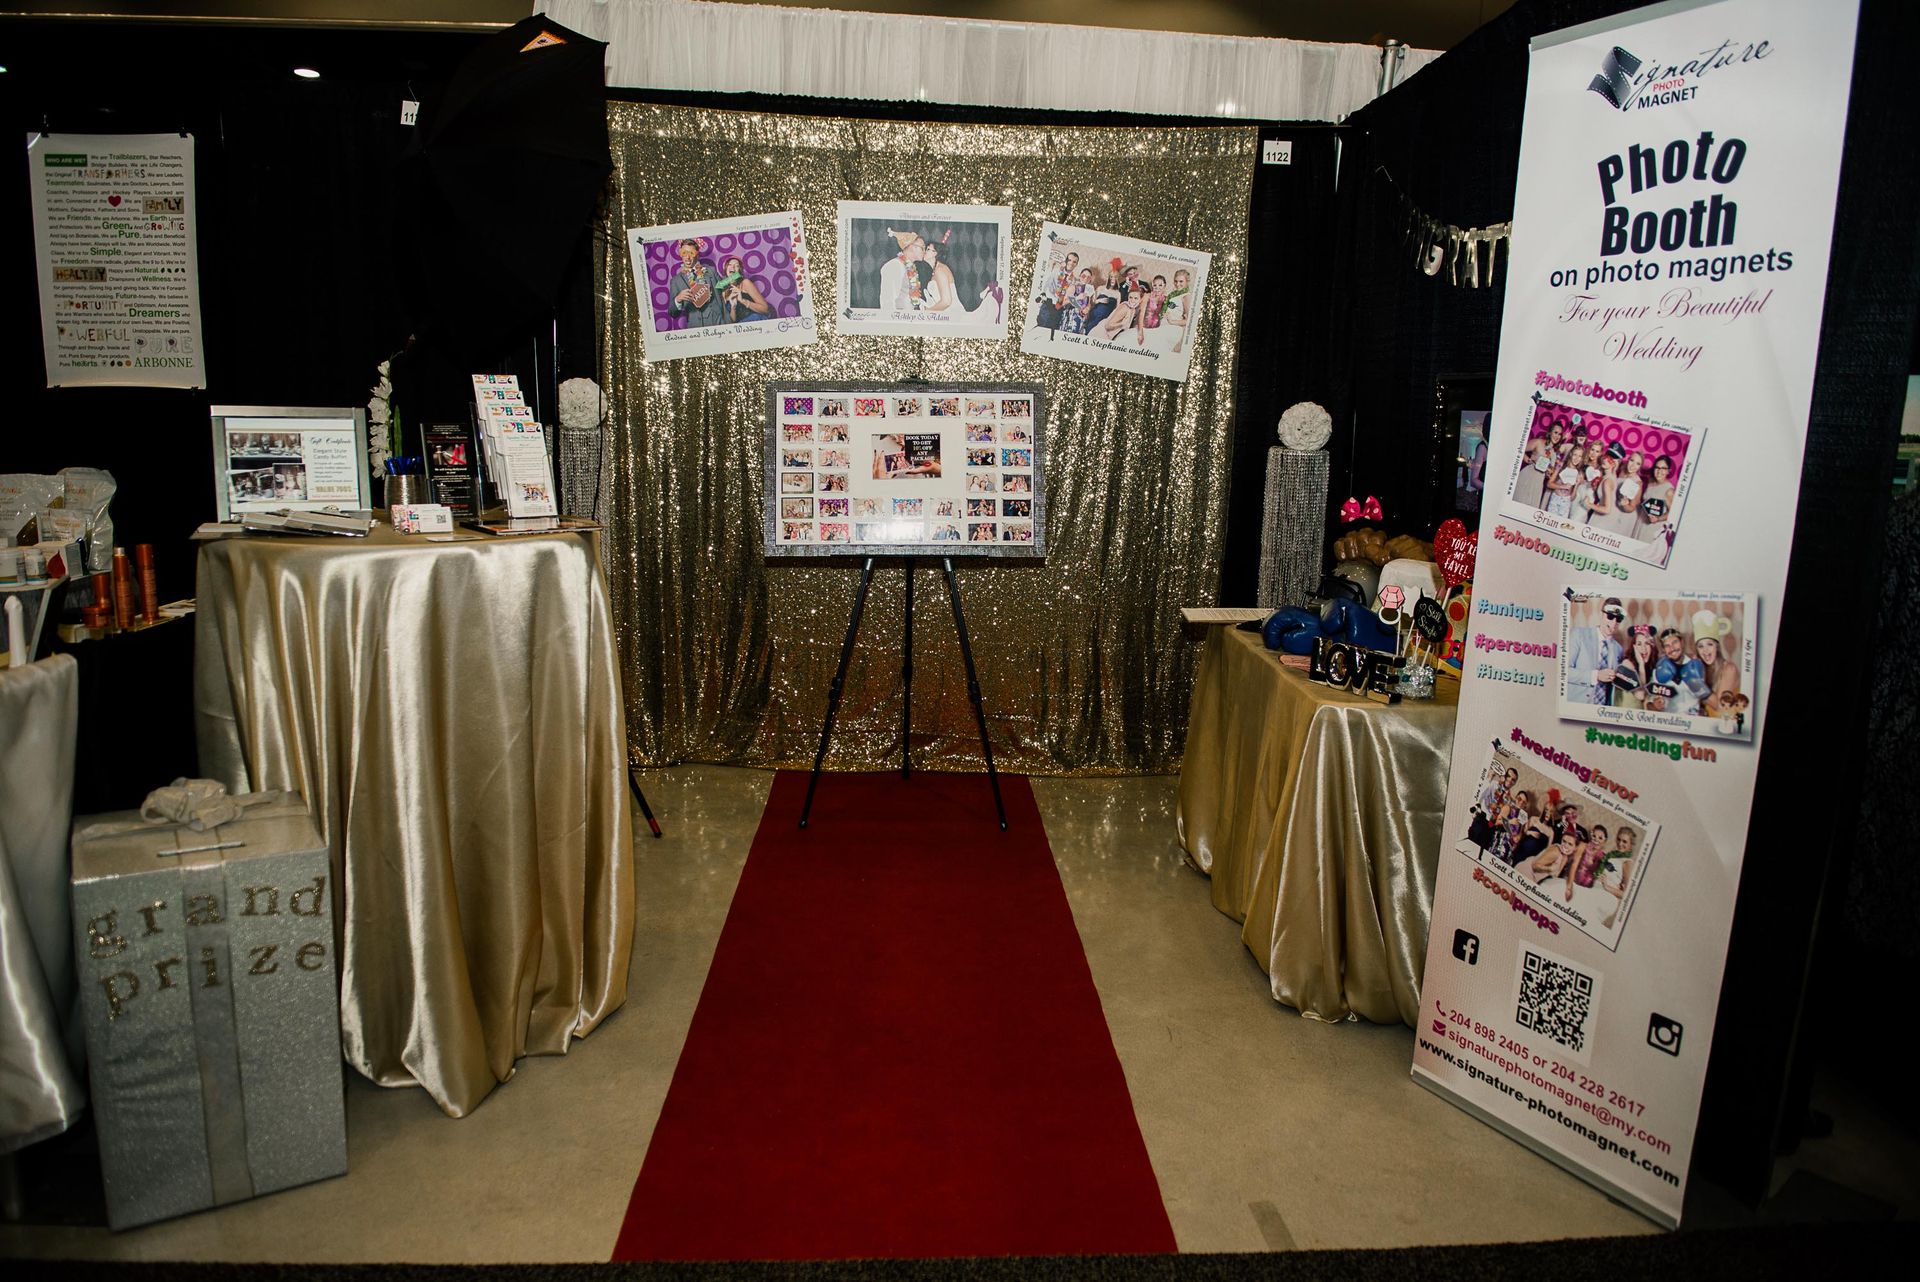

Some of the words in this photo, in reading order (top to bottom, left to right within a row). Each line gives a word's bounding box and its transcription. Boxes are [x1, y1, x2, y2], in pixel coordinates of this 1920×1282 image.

[1637, 86, 1699, 110] MAGNET
[1652, 78, 1685, 92] PHOTO
[1266, 151, 1289, 162] 1122
[1597, 131, 1747, 207] Photo
[1600, 193, 1738, 257] Booth
[1138, 248, 1157, 257] Thank
[1168, 253, 1178, 261] for
[1550, 268, 1578, 288] on
[1585, 258, 1660, 290] photo
[1668, 247, 1794, 282] magnets
[129, 308, 181, 318] Dreamers
[917, 312, 926, 321] &
[927, 312, 950, 321] Adam
[1558, 294, 1601, 324] For
[1599, 305, 1650, 332] your
[1657, 287, 1774, 325] Beautiful
[735, 324, 763, 334] Wedding
[1061, 333, 1081, 344] Scott
[1082, 338, 1090, 346] &
[1091, 338, 1128, 353] Stephanie
[1129, 344, 1160, 360] wedding
[134, 357, 194, 368] ARBONNE
[1602, 326, 1704, 373] Wedding
[1534, 369, 1648, 408] #photobooth
[1451, 538, 1477, 557] YOU'RE
[1533, 510, 1559, 529] Brian
[1581, 526, 1622, 549] Caterina
[1453, 551, 1465, 561] MY
[1493, 523, 1629, 581] #photomagnets
[1426, 604, 1443, 624] Still
[1476, 597, 1545, 622] #unique
[1474, 632, 1558, 659] #personal
[1309, 635, 1407, 704] LOVE
[1476, 664, 1546, 687] #instant
[1625, 710, 1634, 721] &
[1656, 714, 1692, 731] wedding
[1585, 726, 1718, 763] #weddingfun
[1511, 727, 1639, 803] #weddingfavor
[1602, 799, 1614, 808] you
[1472, 866, 1560, 935] #coolprops
[1489, 857, 1508, 874] Scott
[1507, 871, 1516, 880] &
[1515, 875, 1553, 904] Stephanie
[1553, 902, 1588, 927] wedding
[87, 875, 326, 960] grand
[99, 941, 327, 1022] prize
[1450, 1009, 1471, 1030] 204
[1474, 1021, 1496, 1042] 898
[1498, 1033, 1530, 1060] 2405
[1532, 1054, 1549, 1070] or
[1550, 1060, 1576, 1084] 204
[1580, 1075, 1605, 1099] 228
[1608, 1090, 1646, 1118] 2617
[1448, 1030, 1672, 1155] signaturephotomagnet@my.com
[1419, 1037, 1680, 1188] www.signature-photomagnet.com
